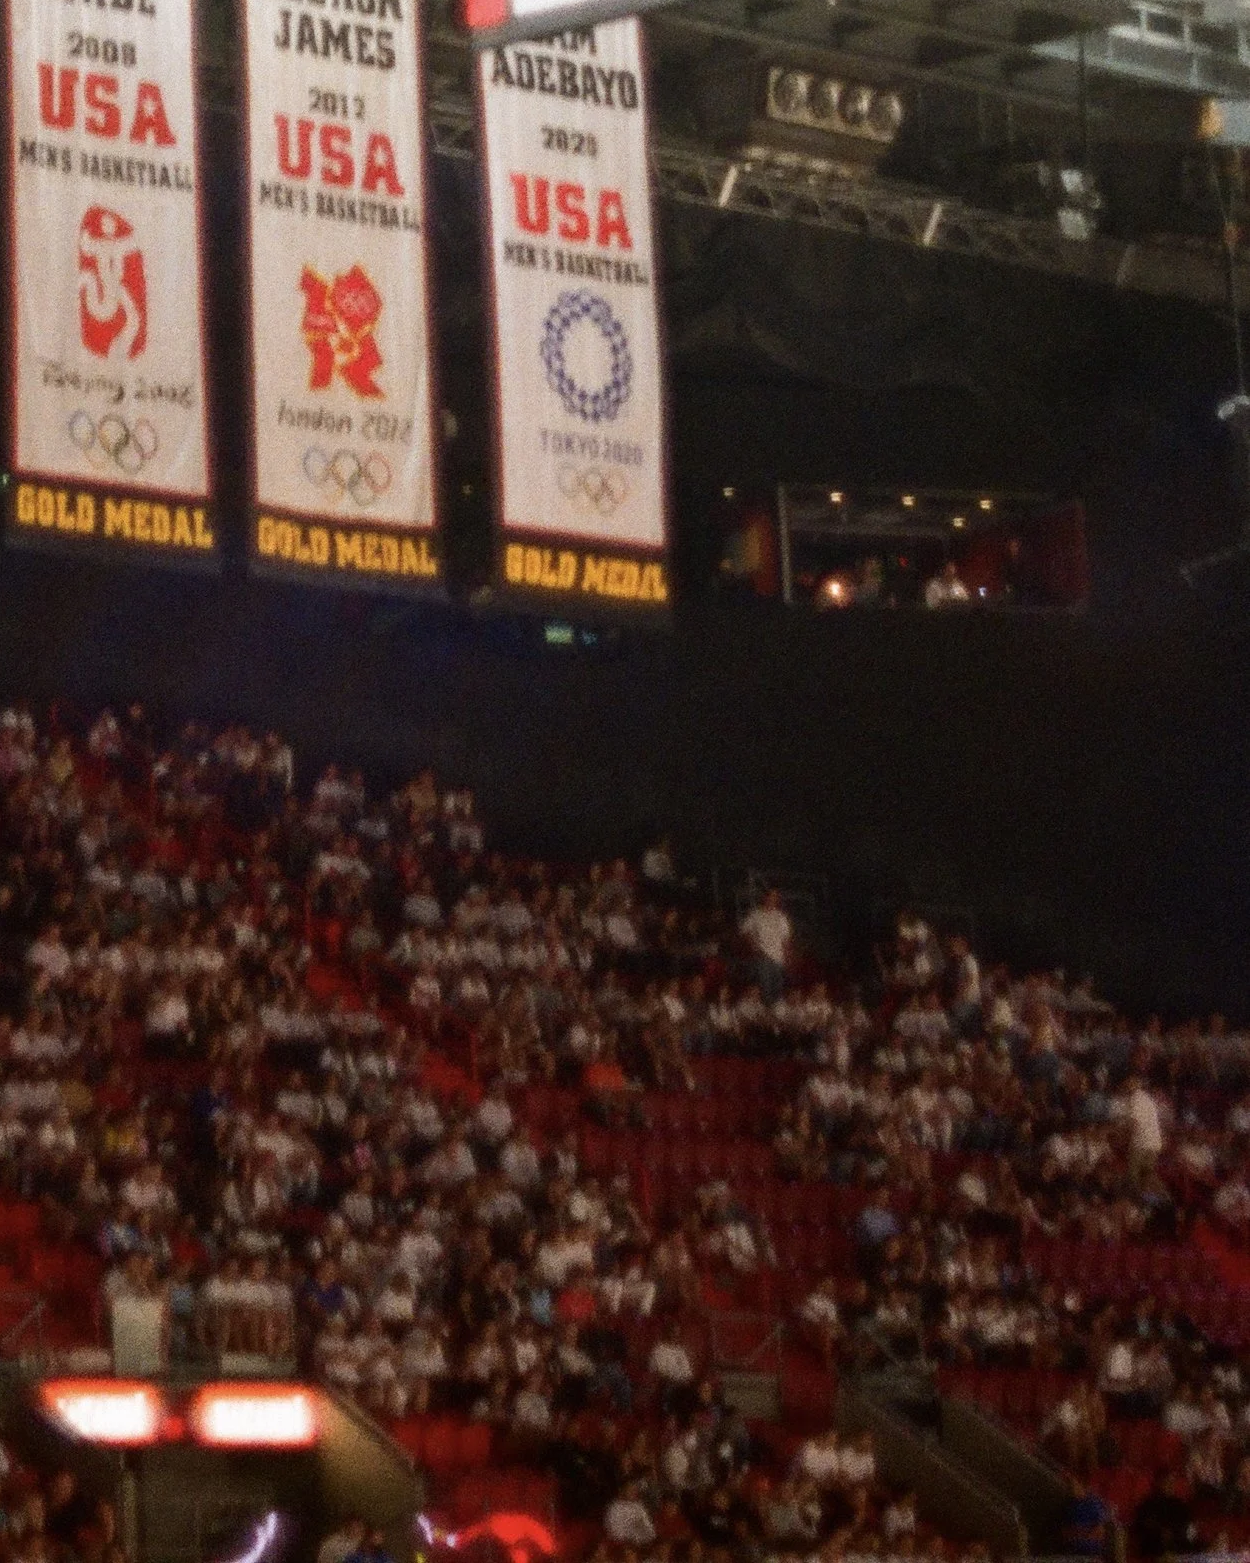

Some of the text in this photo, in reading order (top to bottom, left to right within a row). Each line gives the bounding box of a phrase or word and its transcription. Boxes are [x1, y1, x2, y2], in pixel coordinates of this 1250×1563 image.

[67, 30, 138, 68] 2008
[274, 8, 397, 71] JAMES
[38, 61, 178, 148] USA
[492, 47, 638, 110] ADEBAYO
[274, 111, 406, 198] USA
[509, 172, 633, 252] USA
[16, 484, 214, 550] GOLD MEDAL
[257, 515, 438, 578] GOLD MEDAL
[504, 543, 668, 603] GOLD MEDAL
